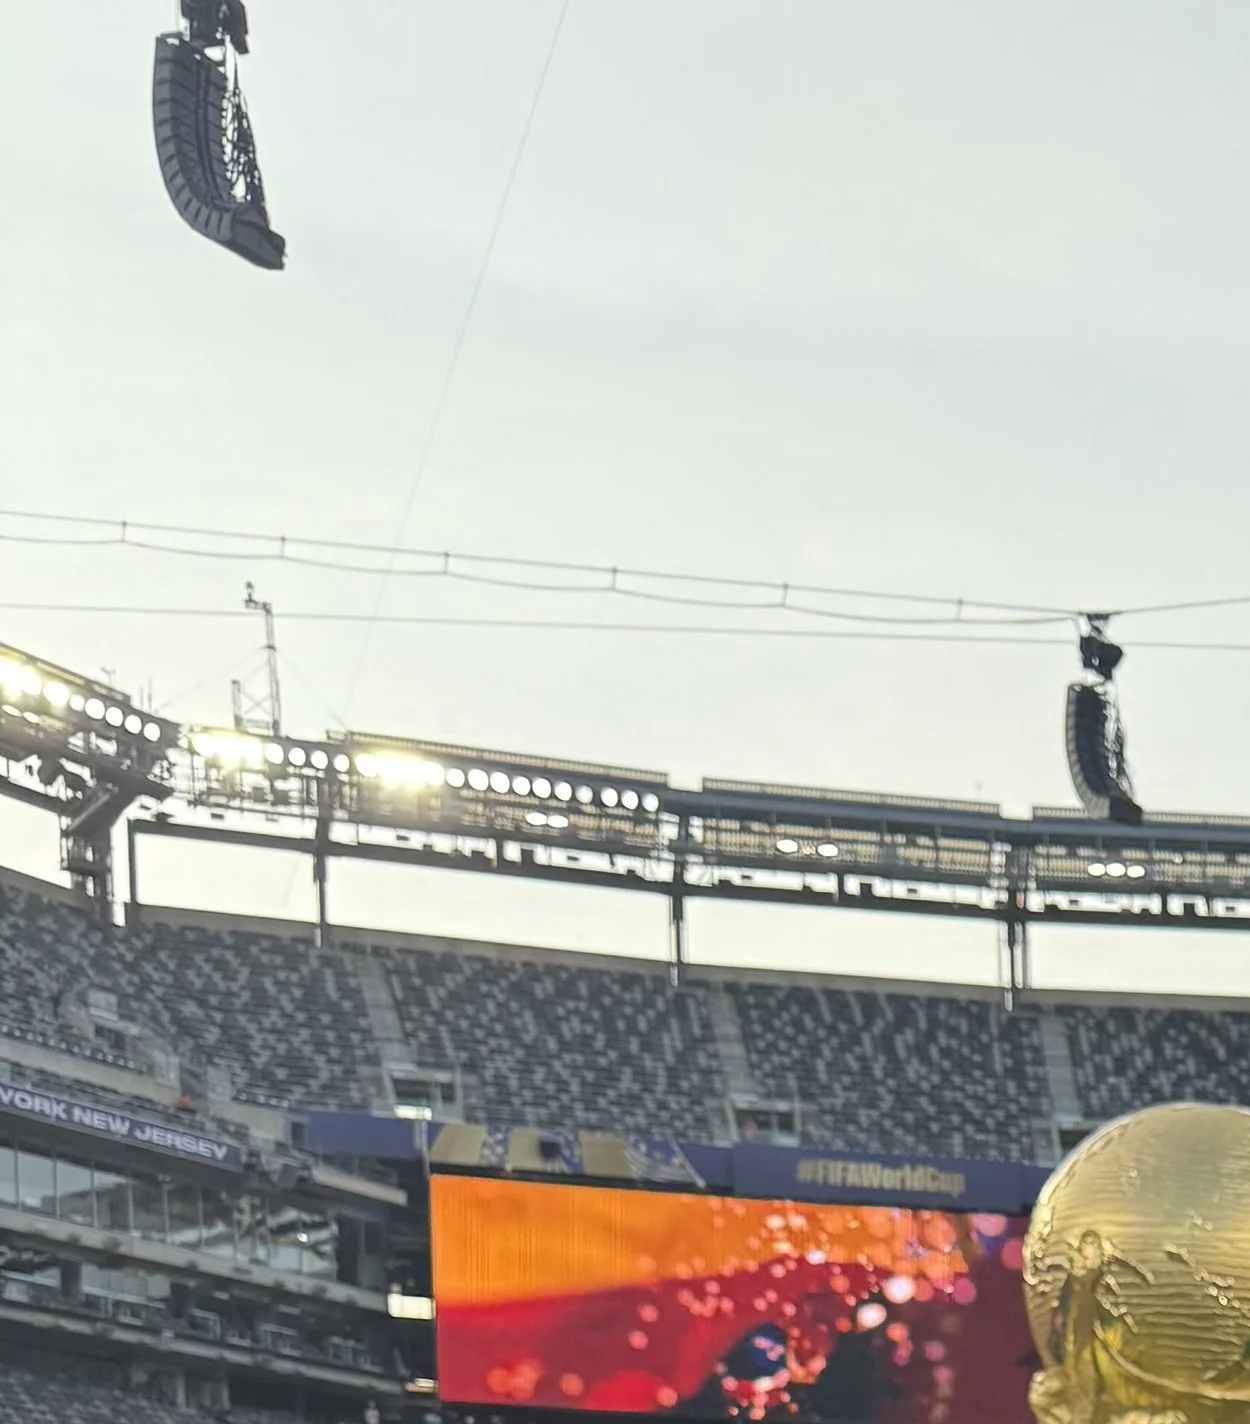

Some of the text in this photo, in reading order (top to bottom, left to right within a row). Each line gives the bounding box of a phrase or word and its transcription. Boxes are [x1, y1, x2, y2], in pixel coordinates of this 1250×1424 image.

[0, 1086, 228, 1161] YORK NEW JERSEY
[796, 1157, 966, 1198] #FIFAWorldCup
